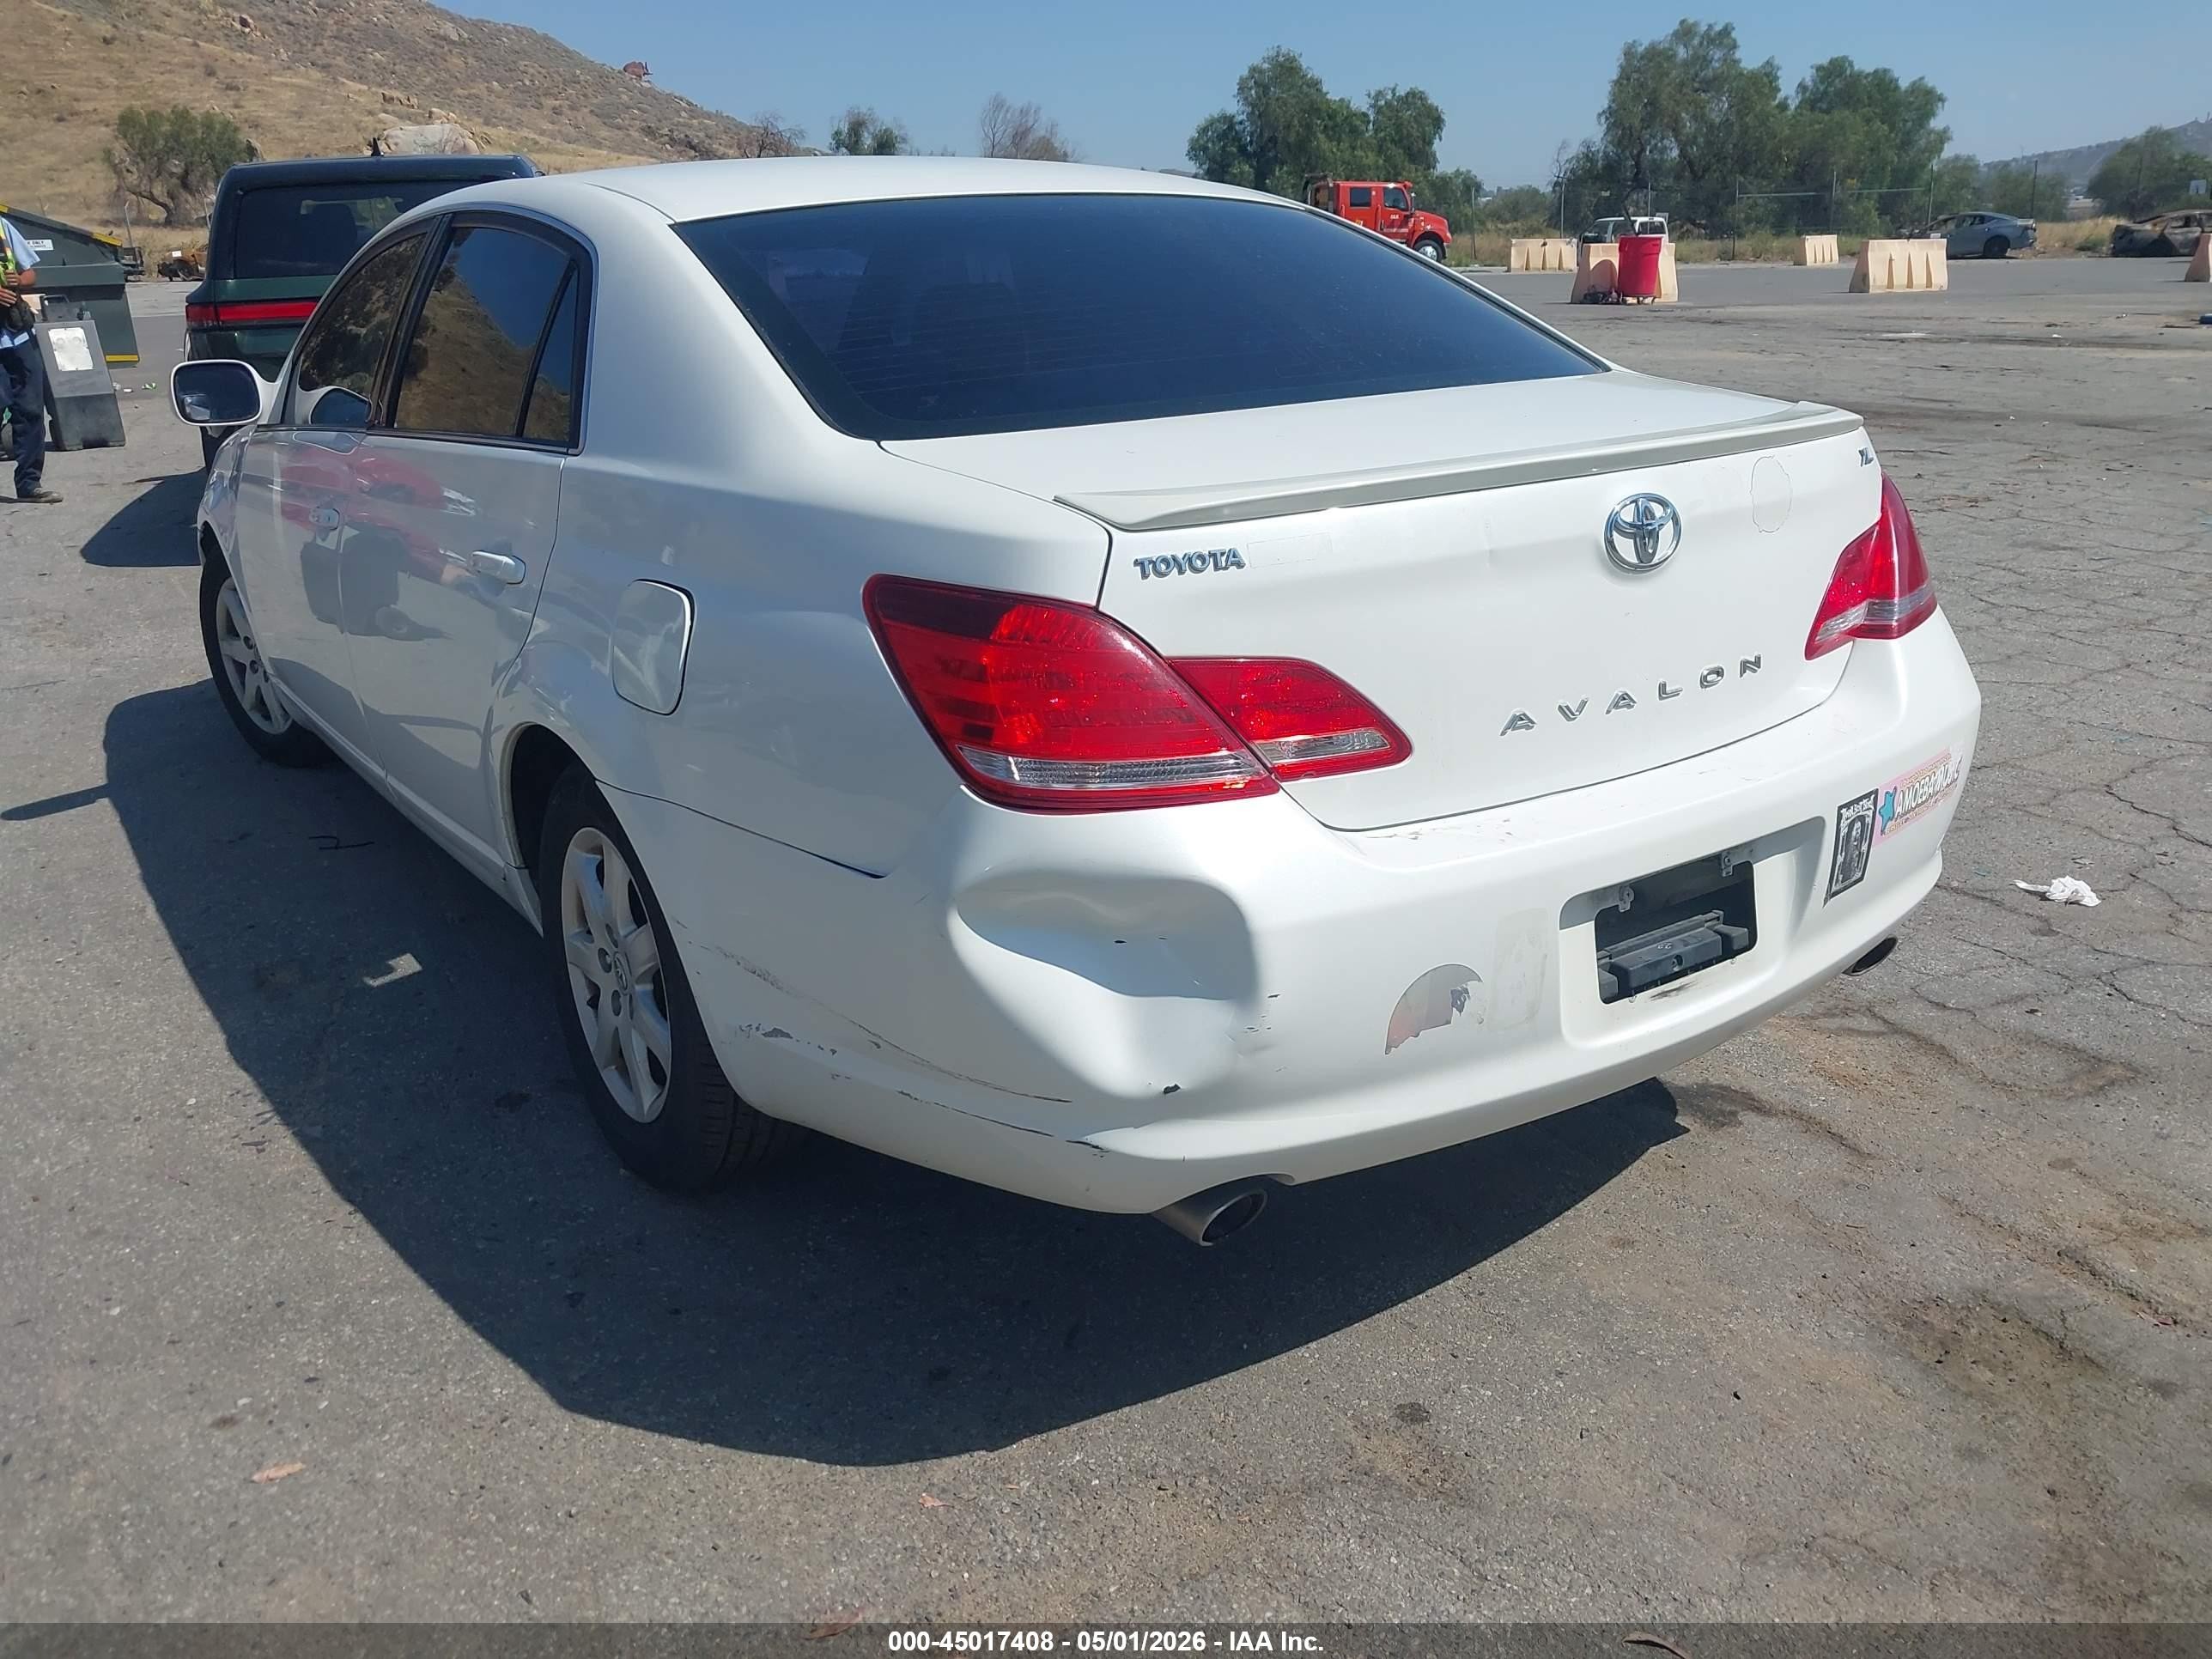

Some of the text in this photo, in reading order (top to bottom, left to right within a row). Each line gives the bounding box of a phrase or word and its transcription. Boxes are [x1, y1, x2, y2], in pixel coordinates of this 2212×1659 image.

[1133, 548, 1246, 580] TOYOTA
[1500, 653, 1762, 737] AVALON
[1895, 772, 1937, 820] AMOEBA
